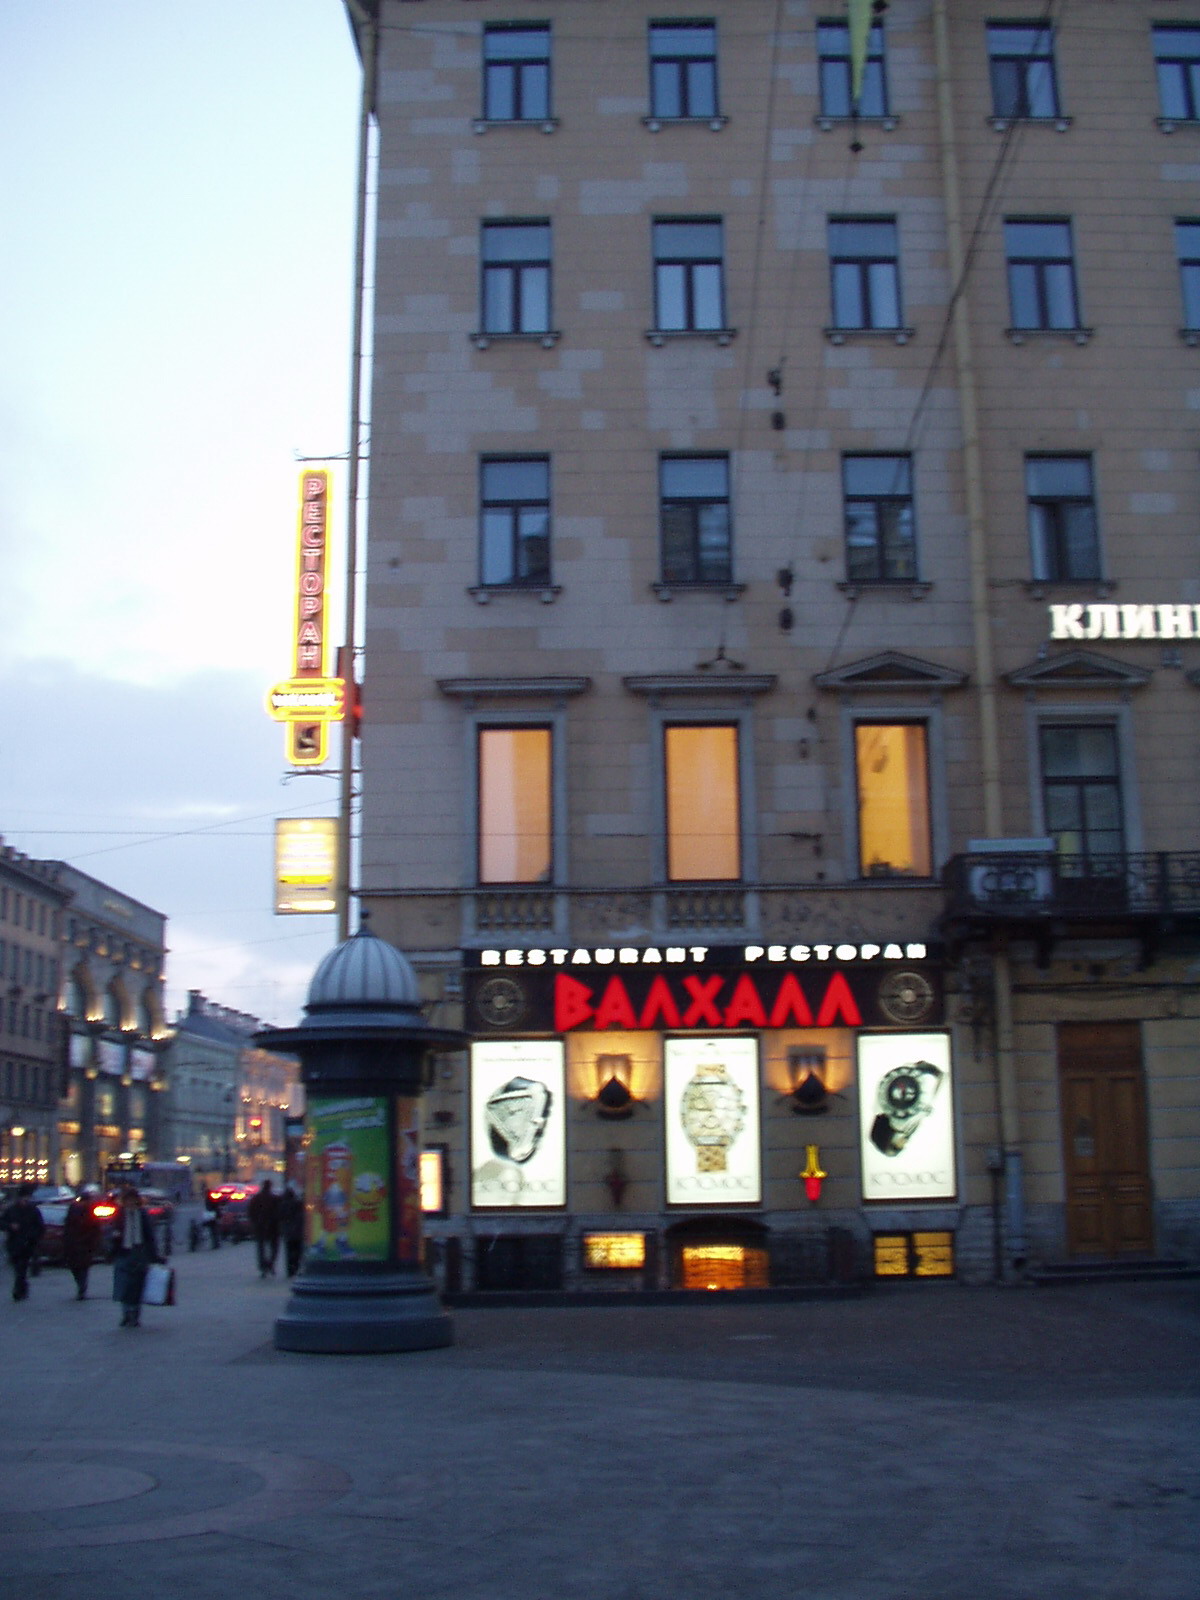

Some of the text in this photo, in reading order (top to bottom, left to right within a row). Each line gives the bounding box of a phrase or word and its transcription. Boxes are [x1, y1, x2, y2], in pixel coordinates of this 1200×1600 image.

[297, 478, 325, 669] РЕСТОРАН
[1050, 604, 1200, 639] КЛИН
[480, 946, 709, 966] RESTAURANT
[744, 943, 927, 962] РЕСТОРАН
[555, 972, 863, 1033] ВАЛХАЛЛ
